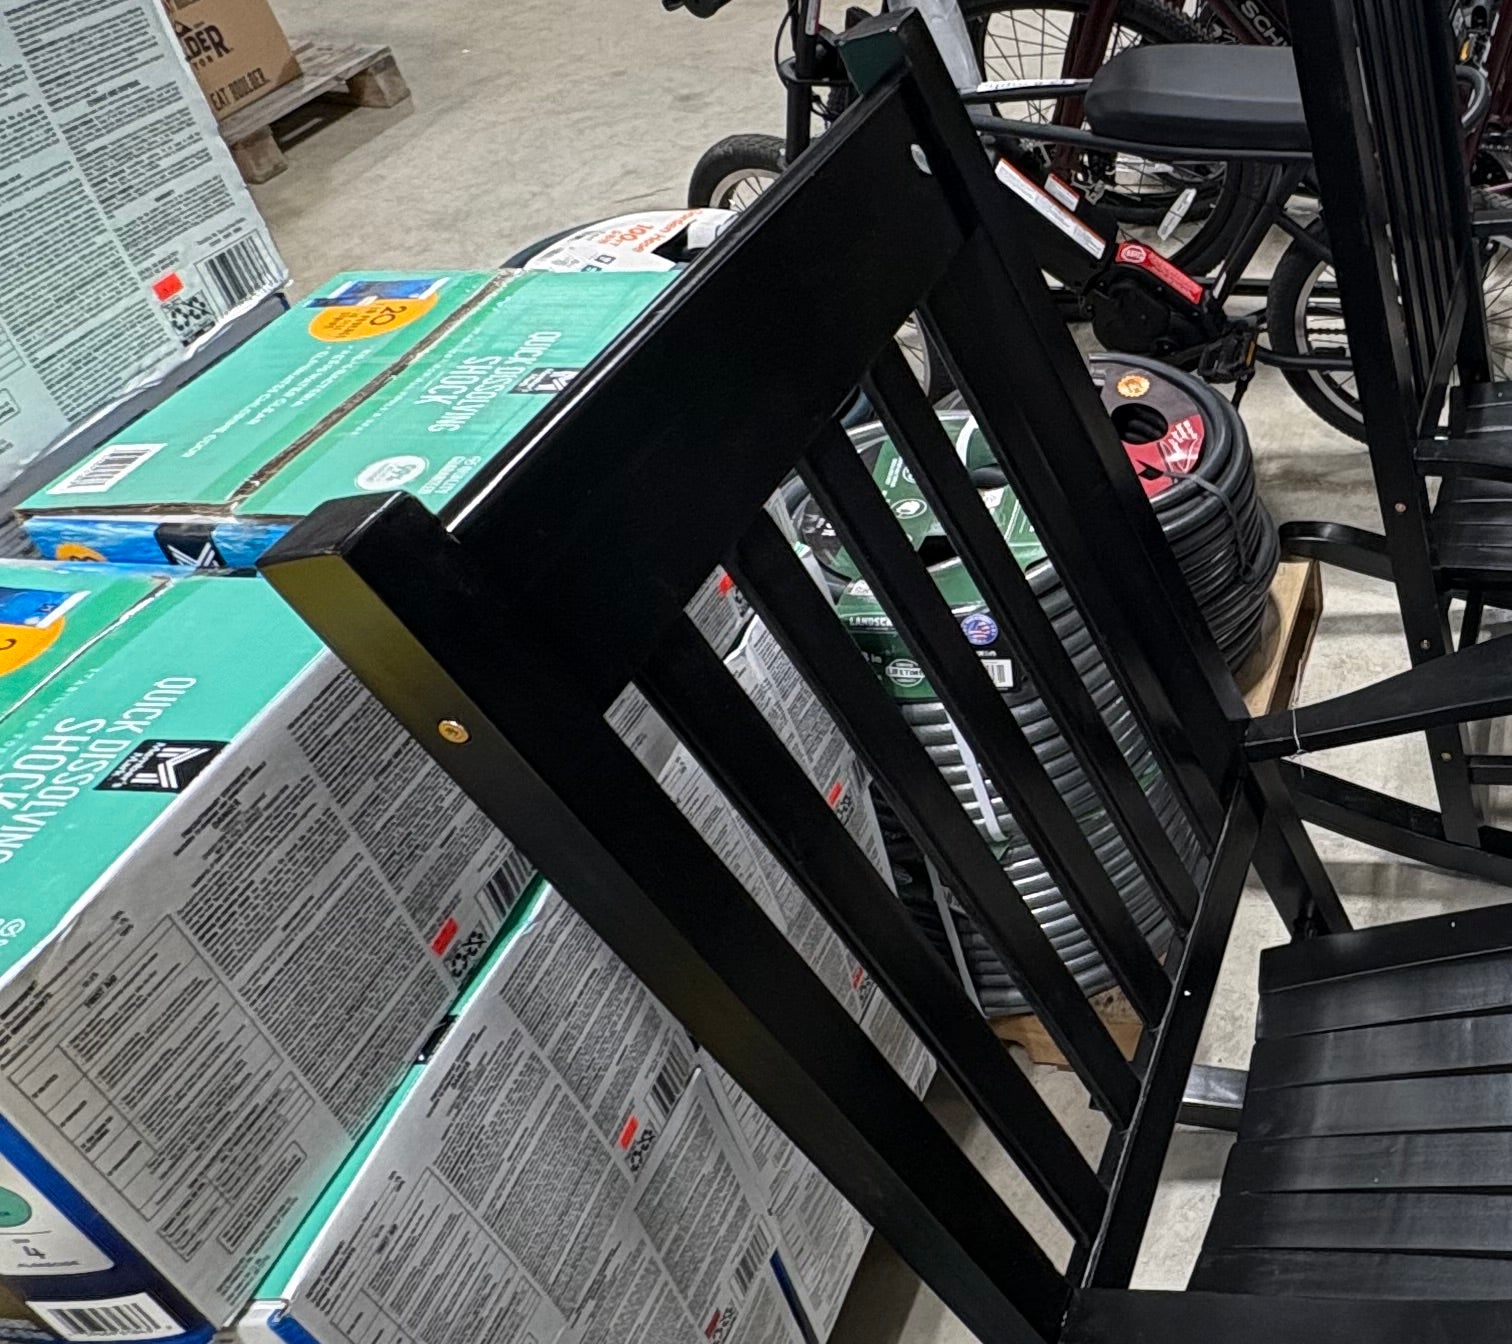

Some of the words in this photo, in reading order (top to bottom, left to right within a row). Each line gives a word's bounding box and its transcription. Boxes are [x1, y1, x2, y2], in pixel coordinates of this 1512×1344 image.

[505, 331, 562, 365] QUICK
[413, 355, 503, 406] SHOCK
[428, 365, 527, 432] DISSOLVING
[106, 676, 197, 734] QUICK
